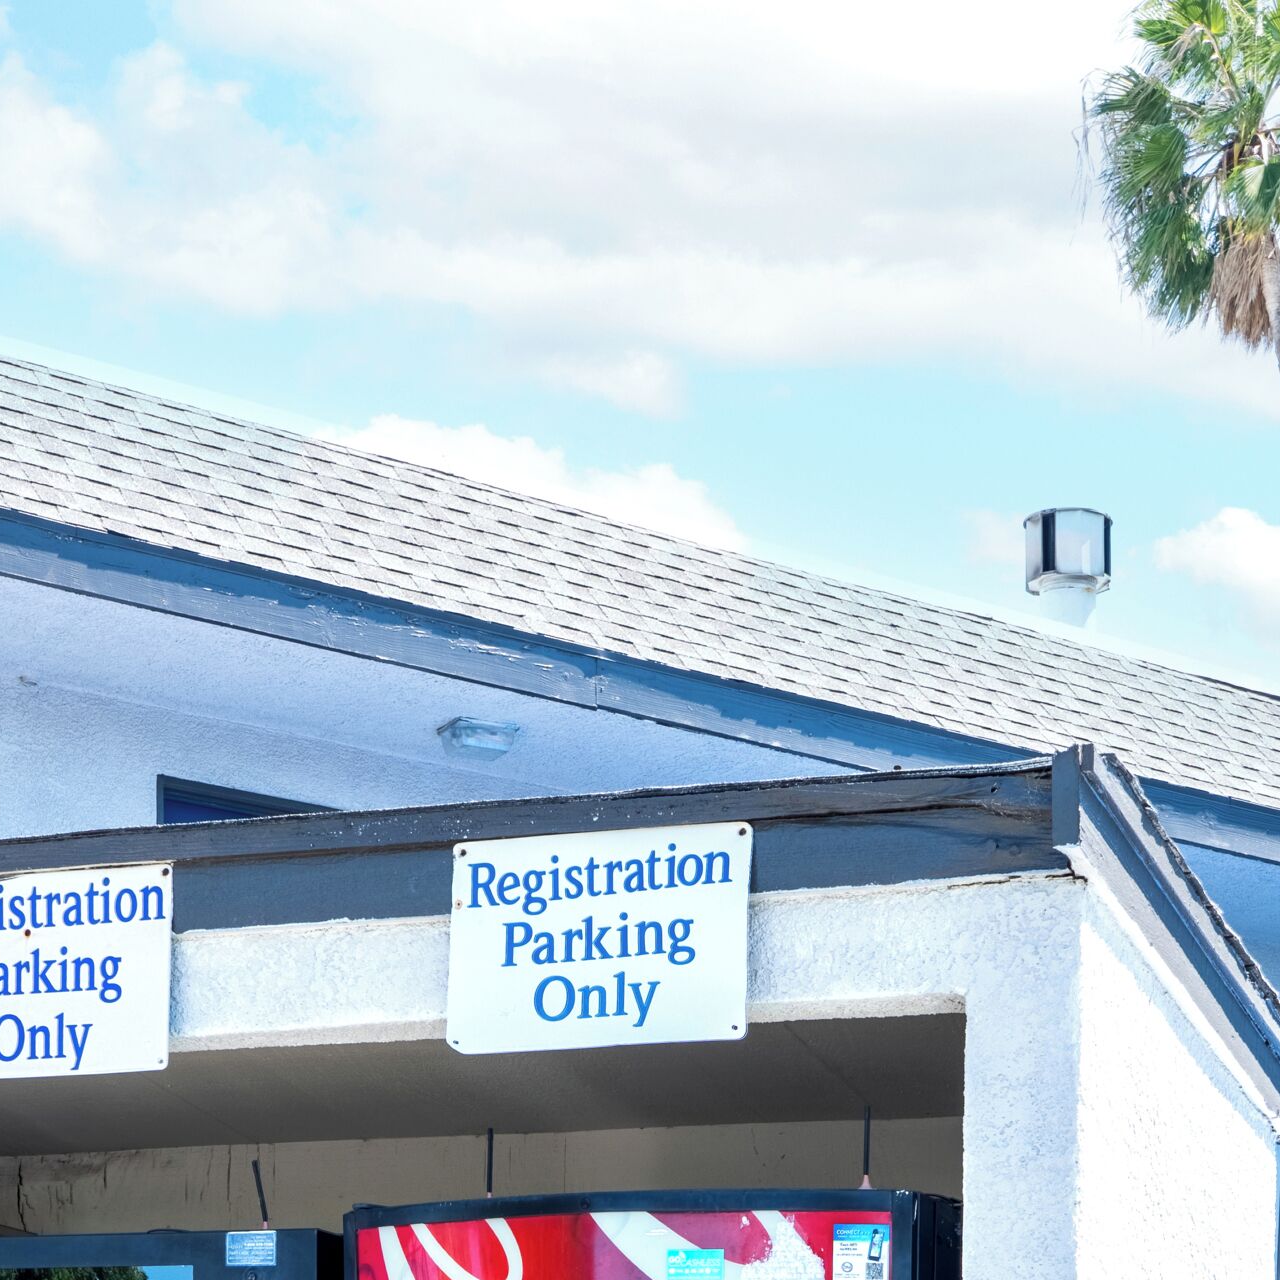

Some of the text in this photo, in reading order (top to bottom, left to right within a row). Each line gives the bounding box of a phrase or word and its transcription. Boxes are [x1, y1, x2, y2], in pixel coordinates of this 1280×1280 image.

[467, 843, 733, 916] Registration
[501, 911, 696, 966] Parking
[533, 971, 661, 1027] Only
